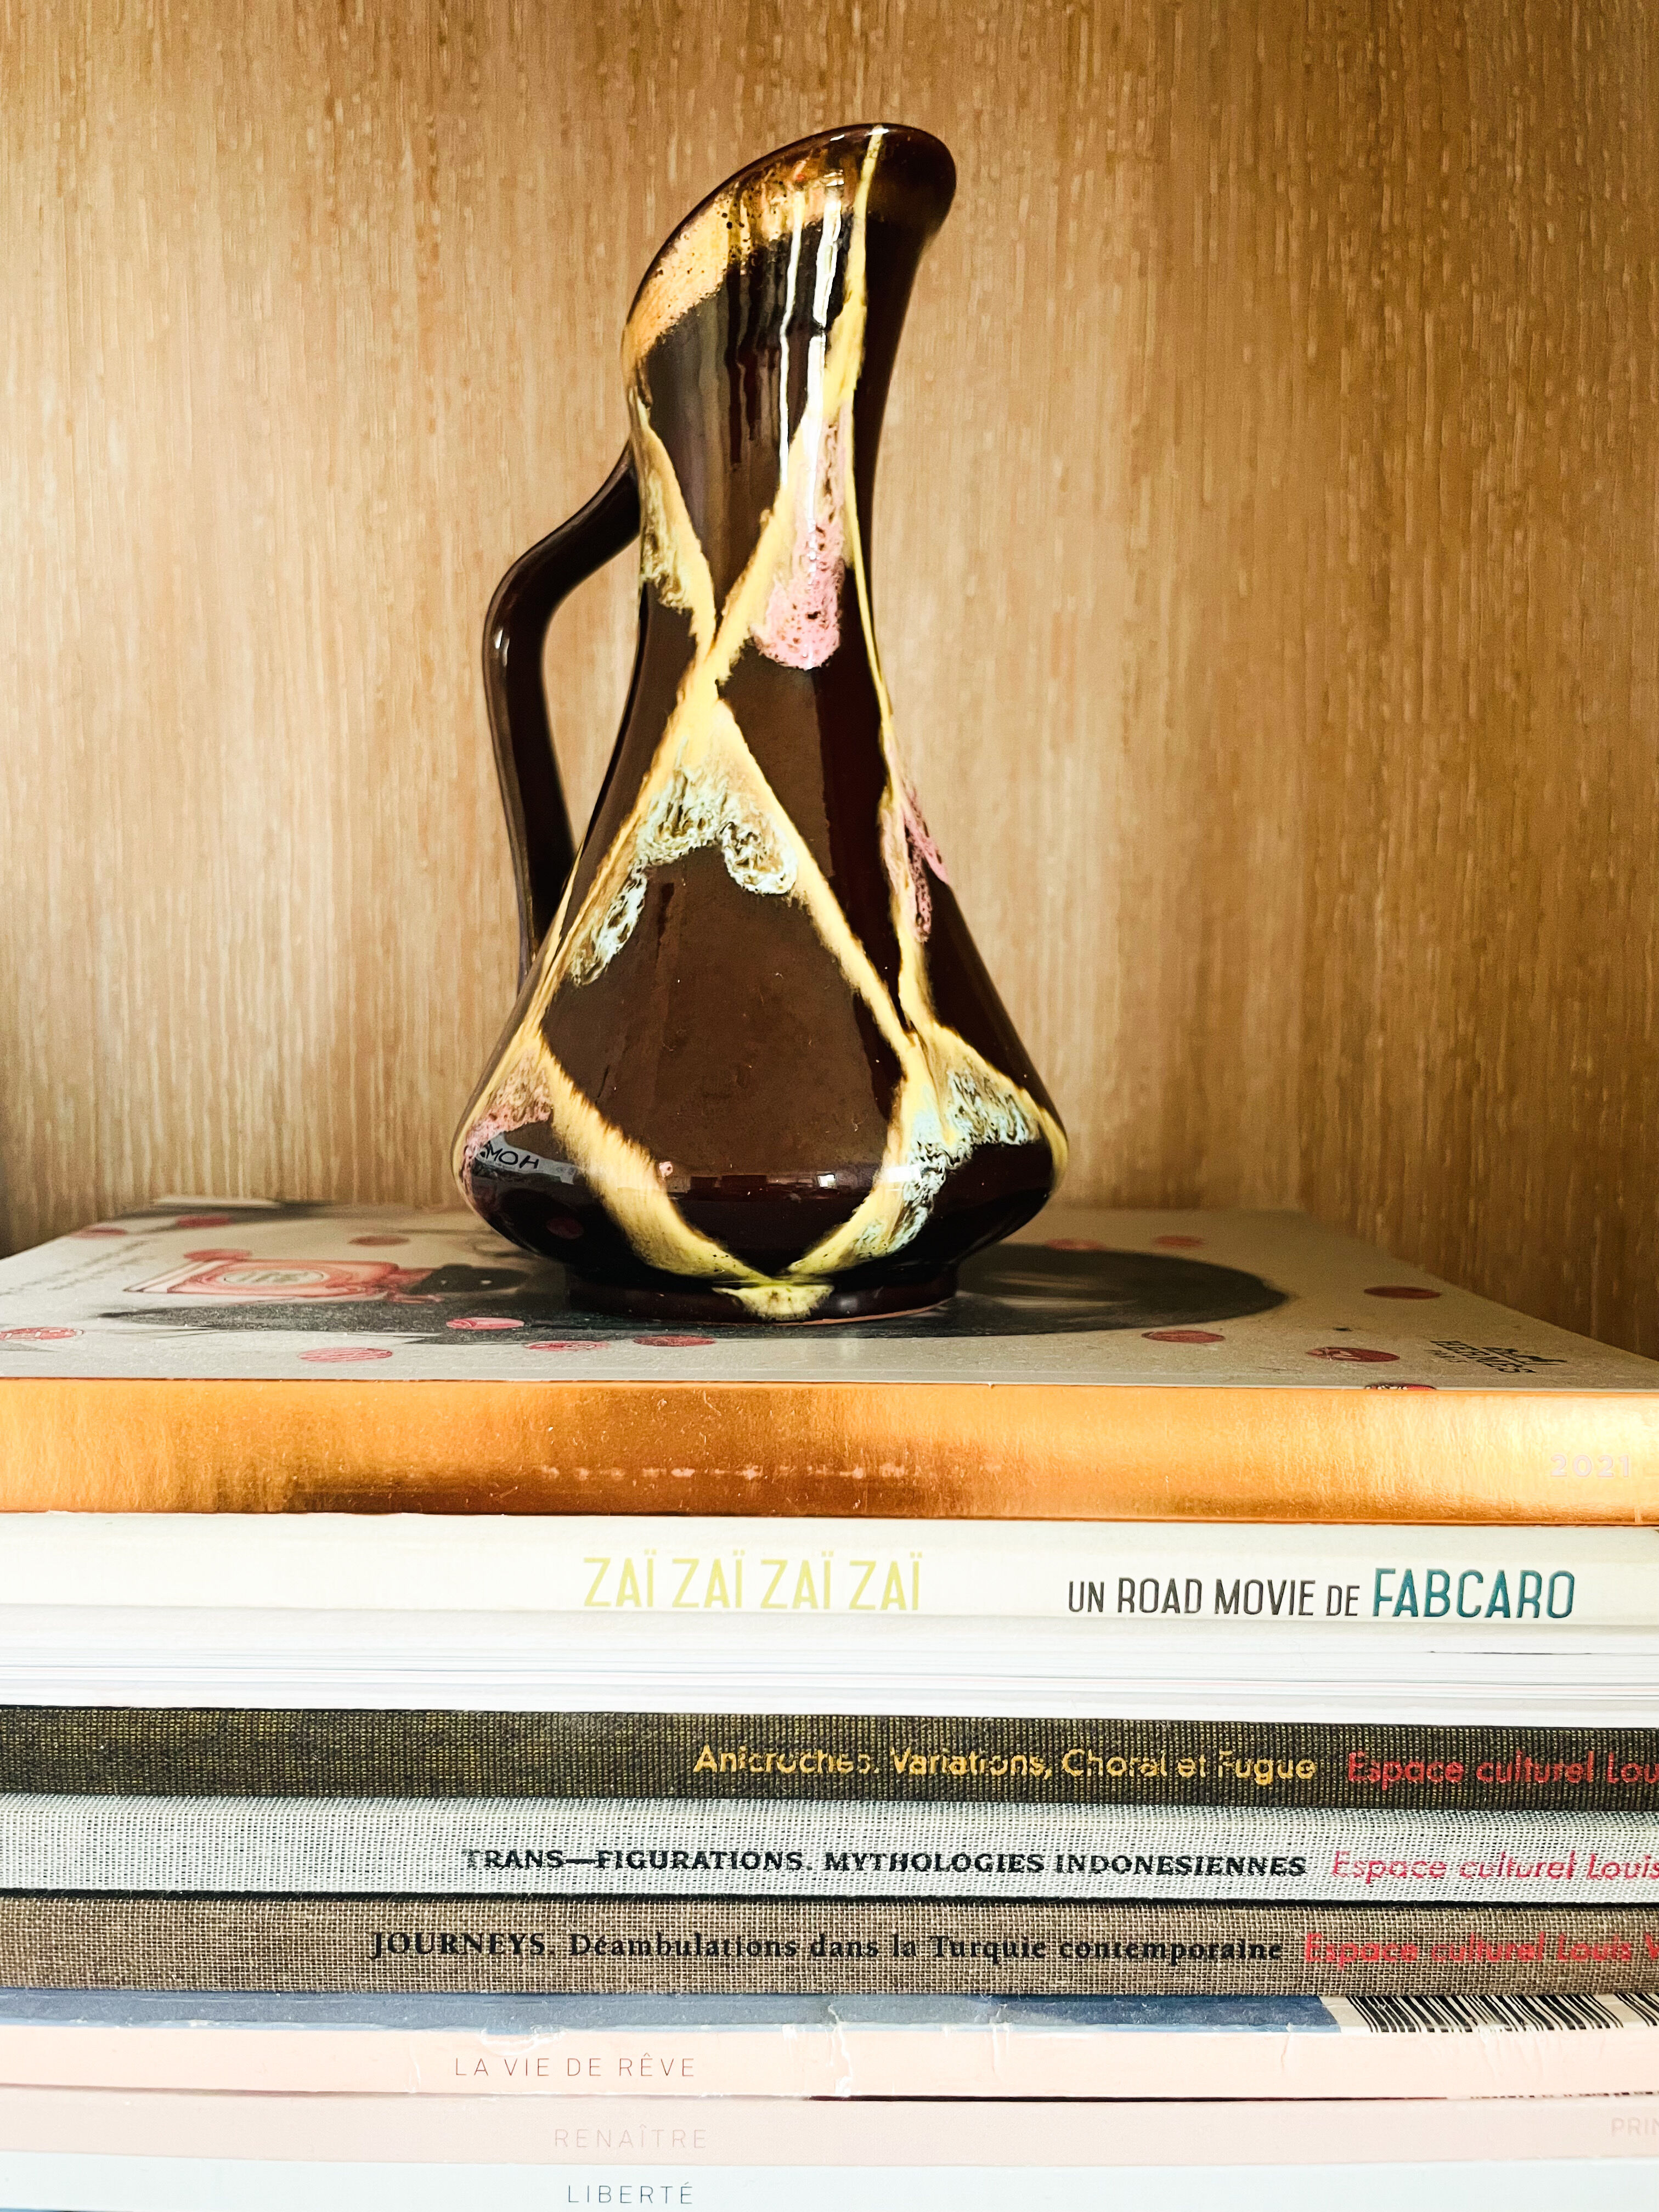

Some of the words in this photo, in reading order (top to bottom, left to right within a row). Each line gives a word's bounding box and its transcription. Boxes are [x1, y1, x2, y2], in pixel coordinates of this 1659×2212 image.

[1550, 1454, 1630, 1479] 2021
[583, 1548, 657, 1607] ZAÏ
[672, 1549, 746, 1609] ZAÏ
[760, 1550, 834, 1610] ZAÏ
[848, 1551, 923, 1611] ZAÏ
[1068, 1581, 1104, 1613] UN
[1117, 1577, 1203, 1614] ROAD
[1214, 1578, 1316, 1616] MOVIE
[1325, 1584, 1360, 1617] DE
[1372, 1567, 1576, 1619] FABCARO
[890, 1746, 1053, 1780] Variations,
[1062, 1748, 1167, 1778] Choral
[1177, 1754, 1206, 1779] et
[1217, 1750, 1317, 1786] Fugue
[1347, 1750, 1465, 1791] Espace
[1475, 1749, 1594, 1784] culturel
[824, 1852, 1045, 1875] MYTHOLOGIES
[1054, 1854, 1308, 1877] INDONESIENNES
[1331, 1850, 1447, 1884] Espace
[1459, 1850, 1576, 1880] culturel
[1585, 1853, 1659, 1880] Louis
[370, 1931, 556, 1960] JOURNEYS.
[569, 1932, 797, 1957] Déambulations
[810, 1932, 879, 1958] dans
[893, 1933, 917, 1958] la
[930, 1934, 1046, 1966] Turquie
[1059, 1937, 1283, 1967] contemporaine
[1304, 1932, 1419, 1971] Espace
[1430, 1930, 1546, 1963] culturel
[1556, 1933, 1633, 1962] Louis
[455, 2057, 489, 2076] LA
[503, 2057, 550, 2077] VIE
[567, 2057, 602, 2077] DE
[618, 2052, 695, 2078] RÊVE
[555, 2124, 707, 2149] RENAÎTRE
[567, 2181, 693, 2204] LIBERTÉ
